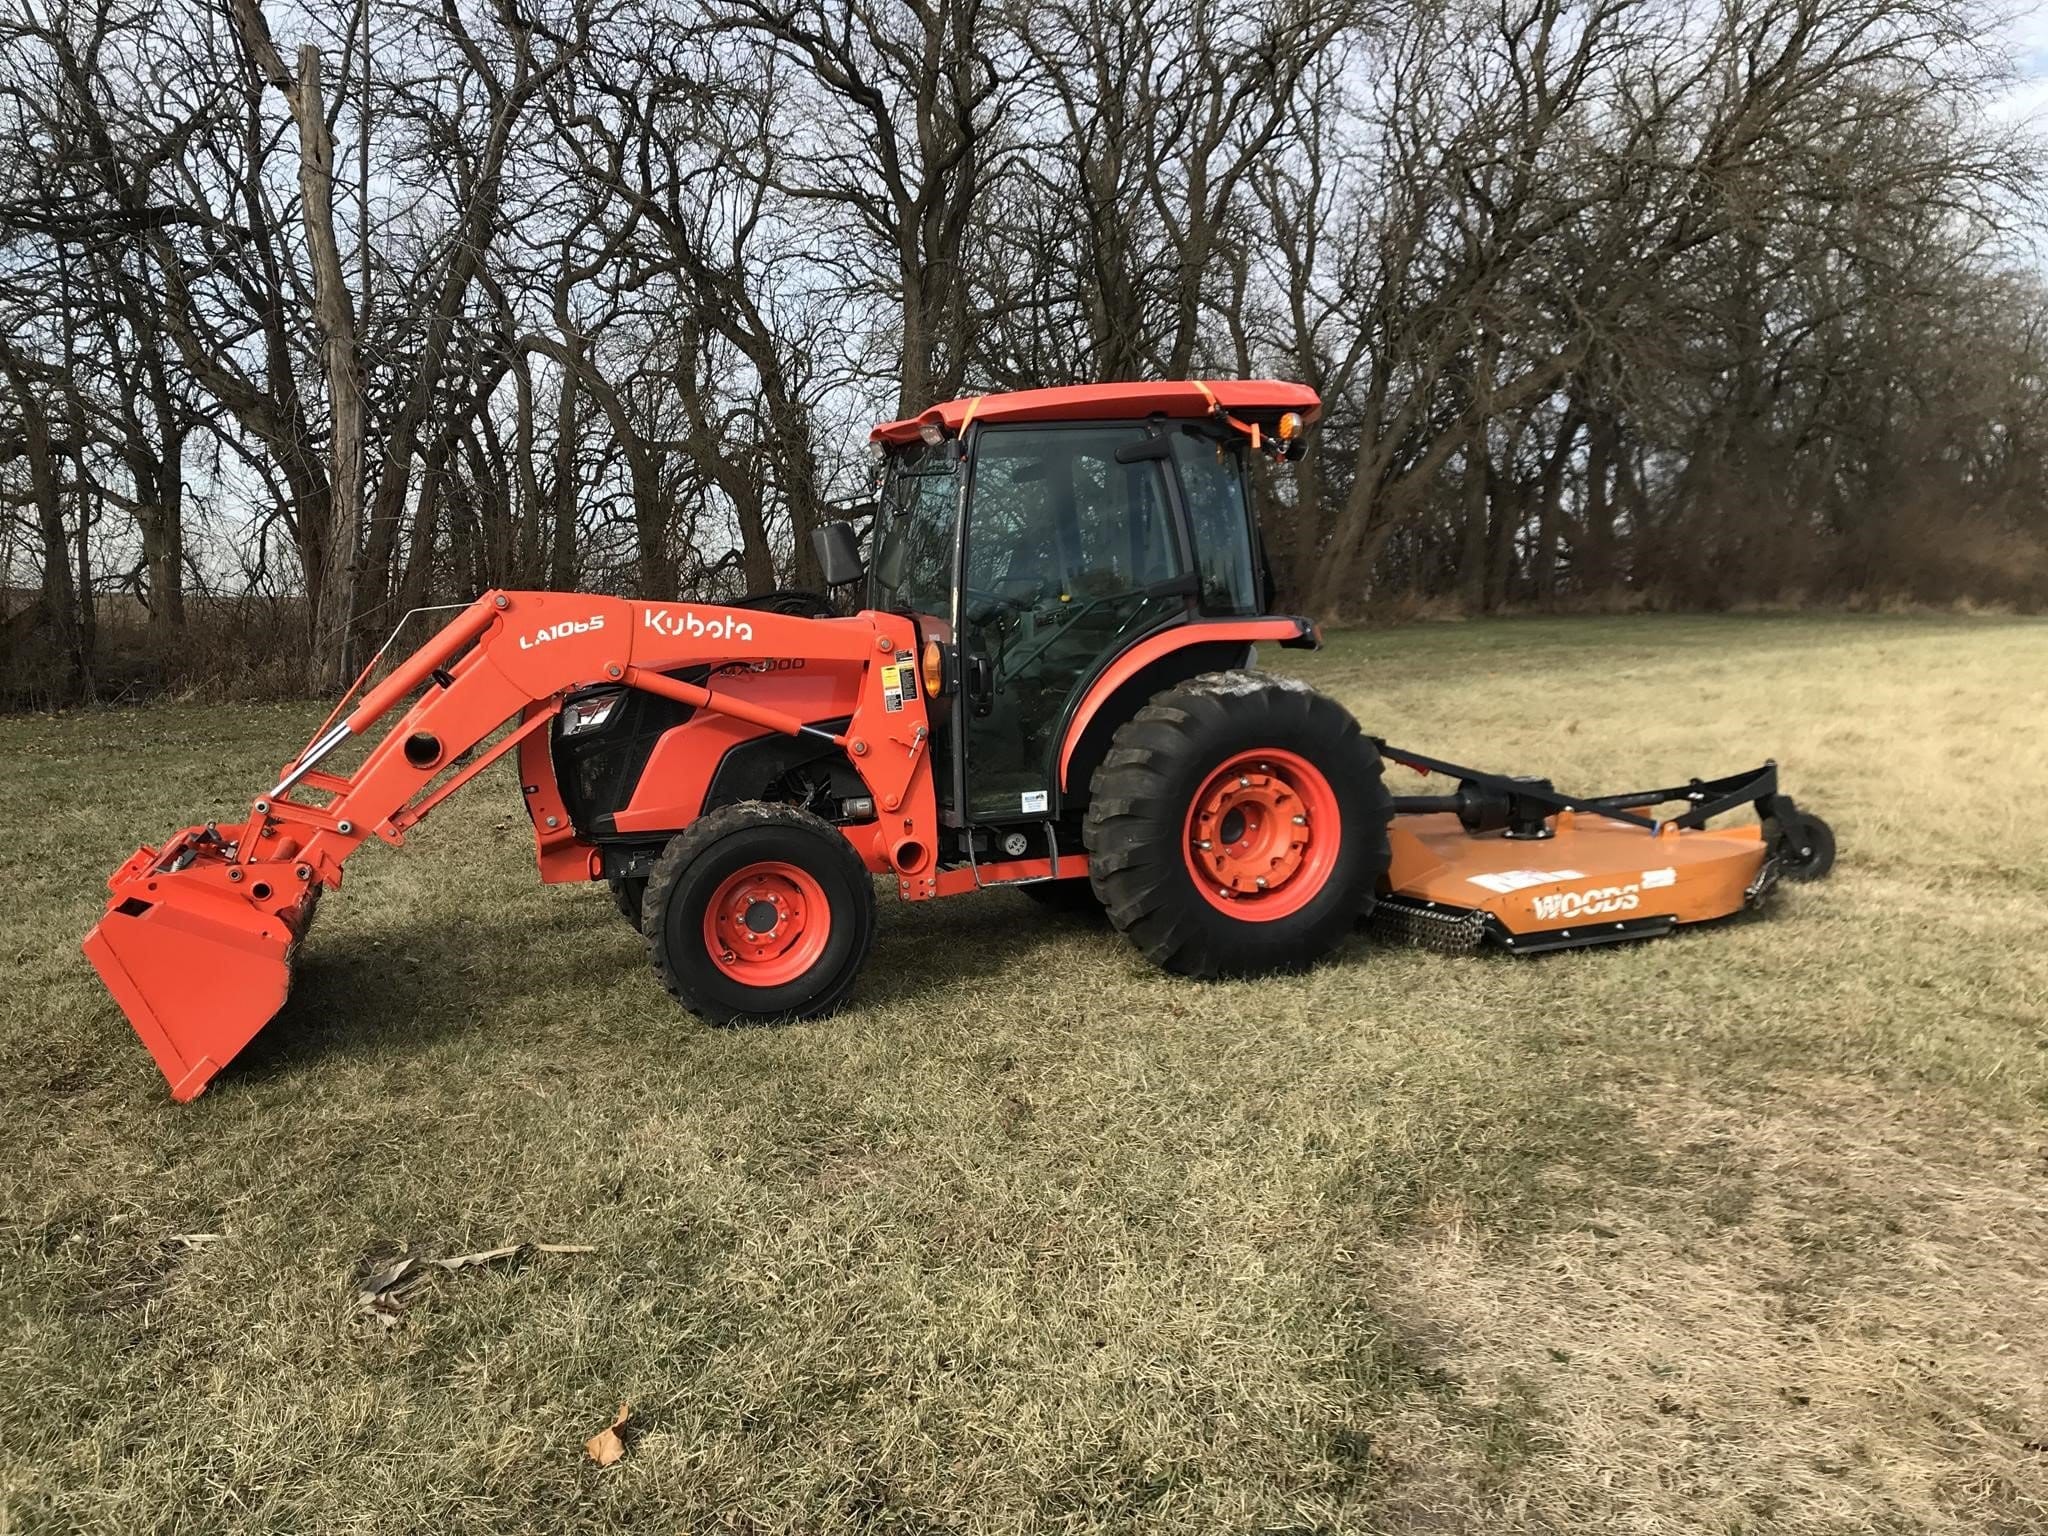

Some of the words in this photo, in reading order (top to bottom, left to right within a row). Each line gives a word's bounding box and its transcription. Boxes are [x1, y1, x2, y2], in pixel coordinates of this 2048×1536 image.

[519, 615, 605, 650] LA1065
[644, 608, 752, 641] Kubota
[1532, 884, 1640, 921] WOODS
